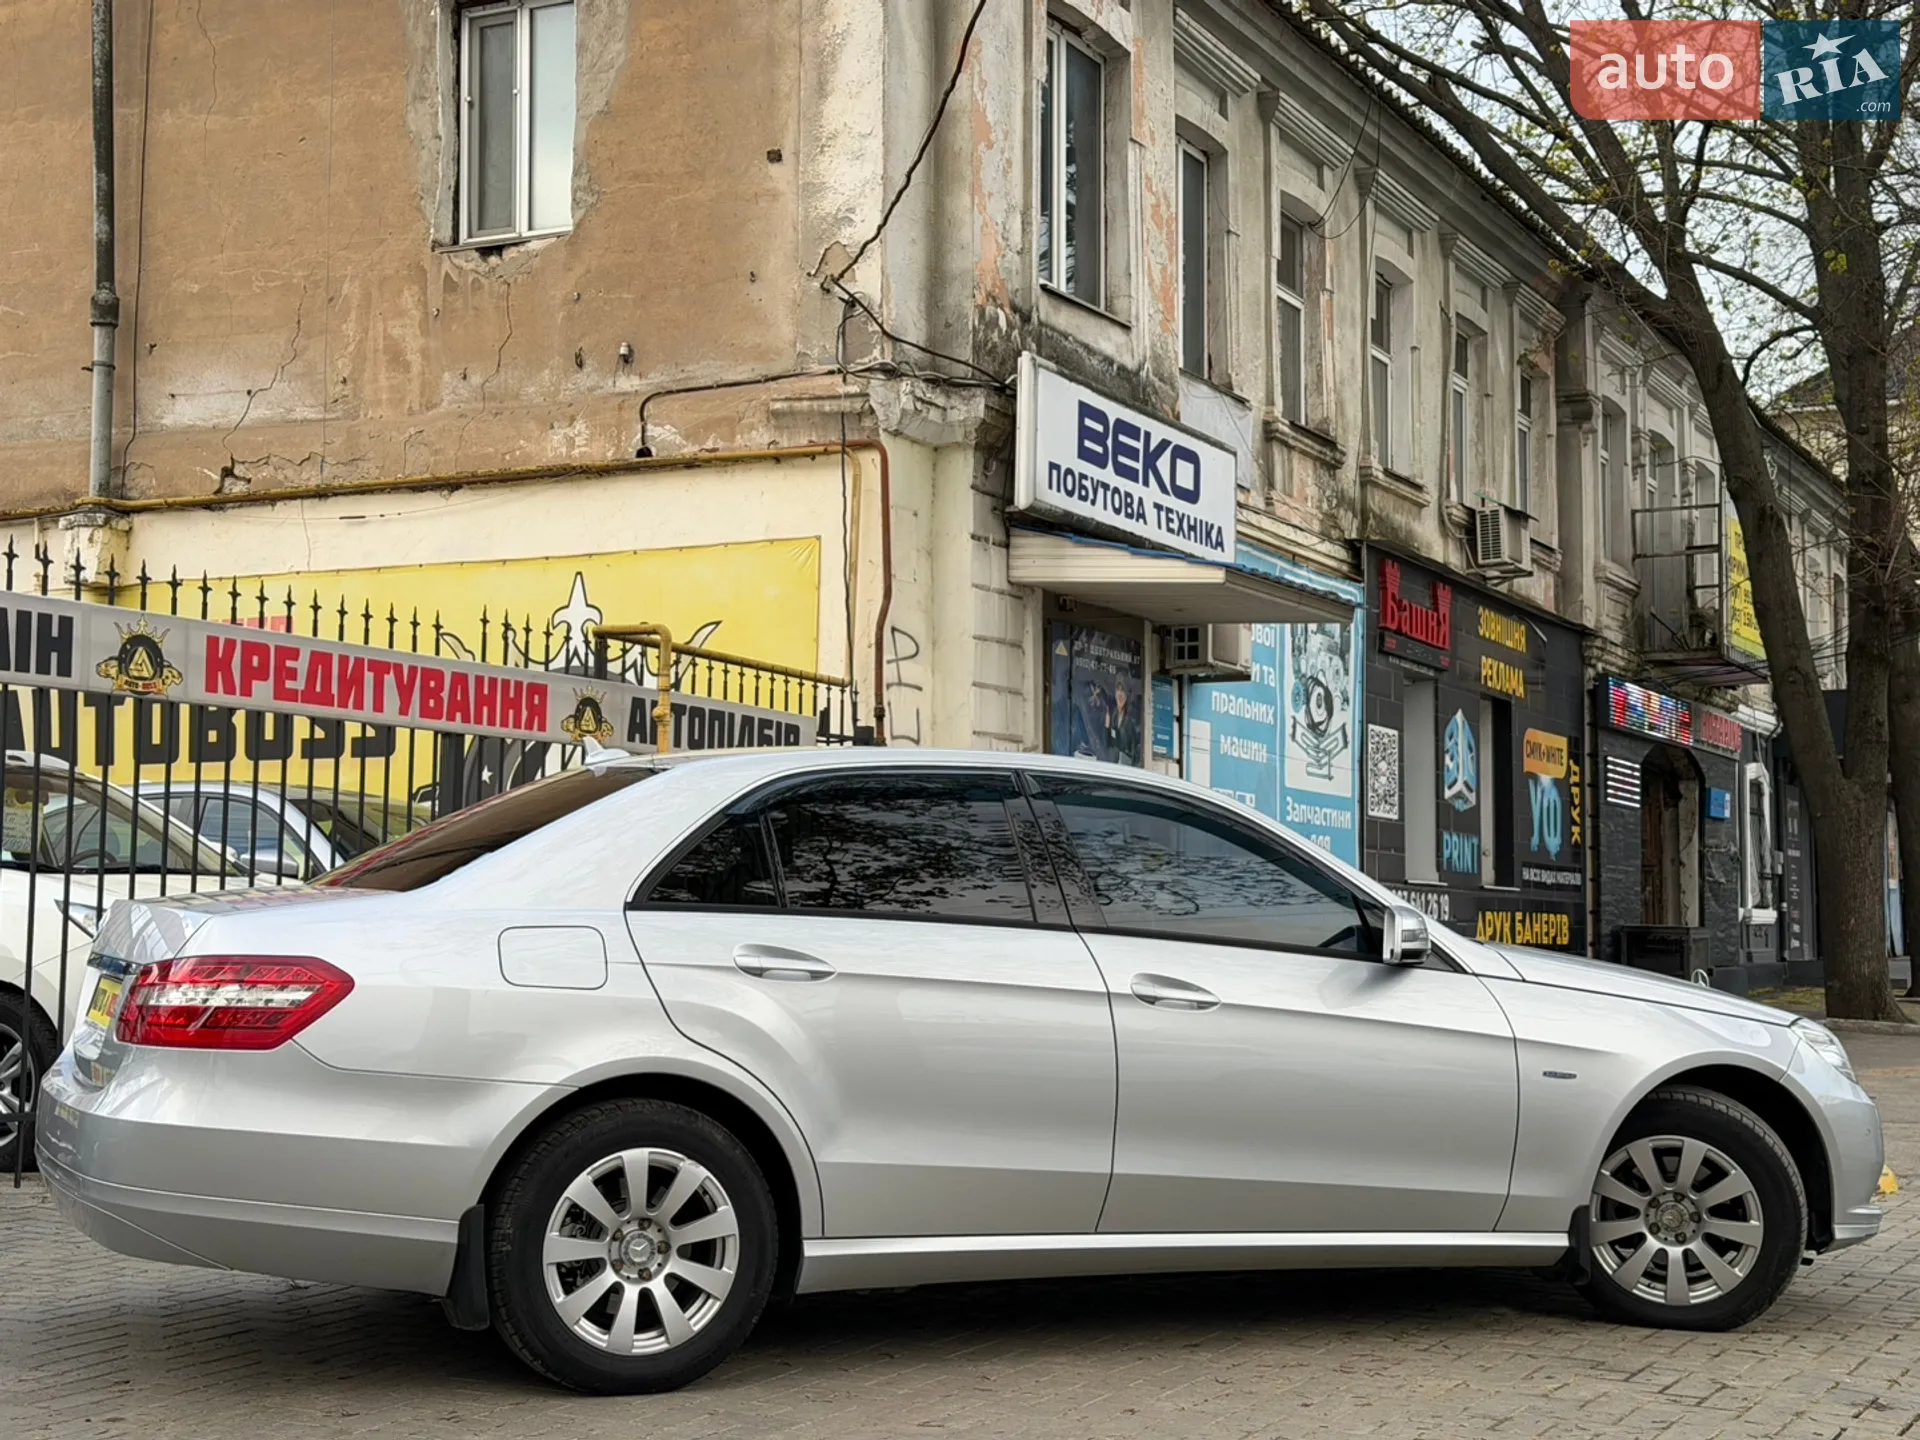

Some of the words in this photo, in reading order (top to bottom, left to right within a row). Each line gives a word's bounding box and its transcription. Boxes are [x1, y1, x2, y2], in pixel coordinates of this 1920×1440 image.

[1077, 399, 1201, 505] BEKO
[1048, 460, 1148, 526] ПОБУТОВА
[1153, 501, 1225, 553] ТЕХНІКА
[1478, 605, 1527, 653] ЗОВНІШНЯ
[205, 635, 548, 732] КРЕДИТУВАННЯ
[1480, 655, 1525, 698] РЕКЛАМА
[1211, 690, 1275, 725] пральних
[1220, 734, 1267, 764] машин
[1286, 795, 1351, 829] Запчастини
[1528, 778, 1562, 861] УФ
[1568, 758, 1582, 846] ДРУК
[1442, 831, 1479, 875] PRINT
[1476, 911, 1511, 945] ДРУК
[1514, 911, 1570, 945] БАНЕРІВ
